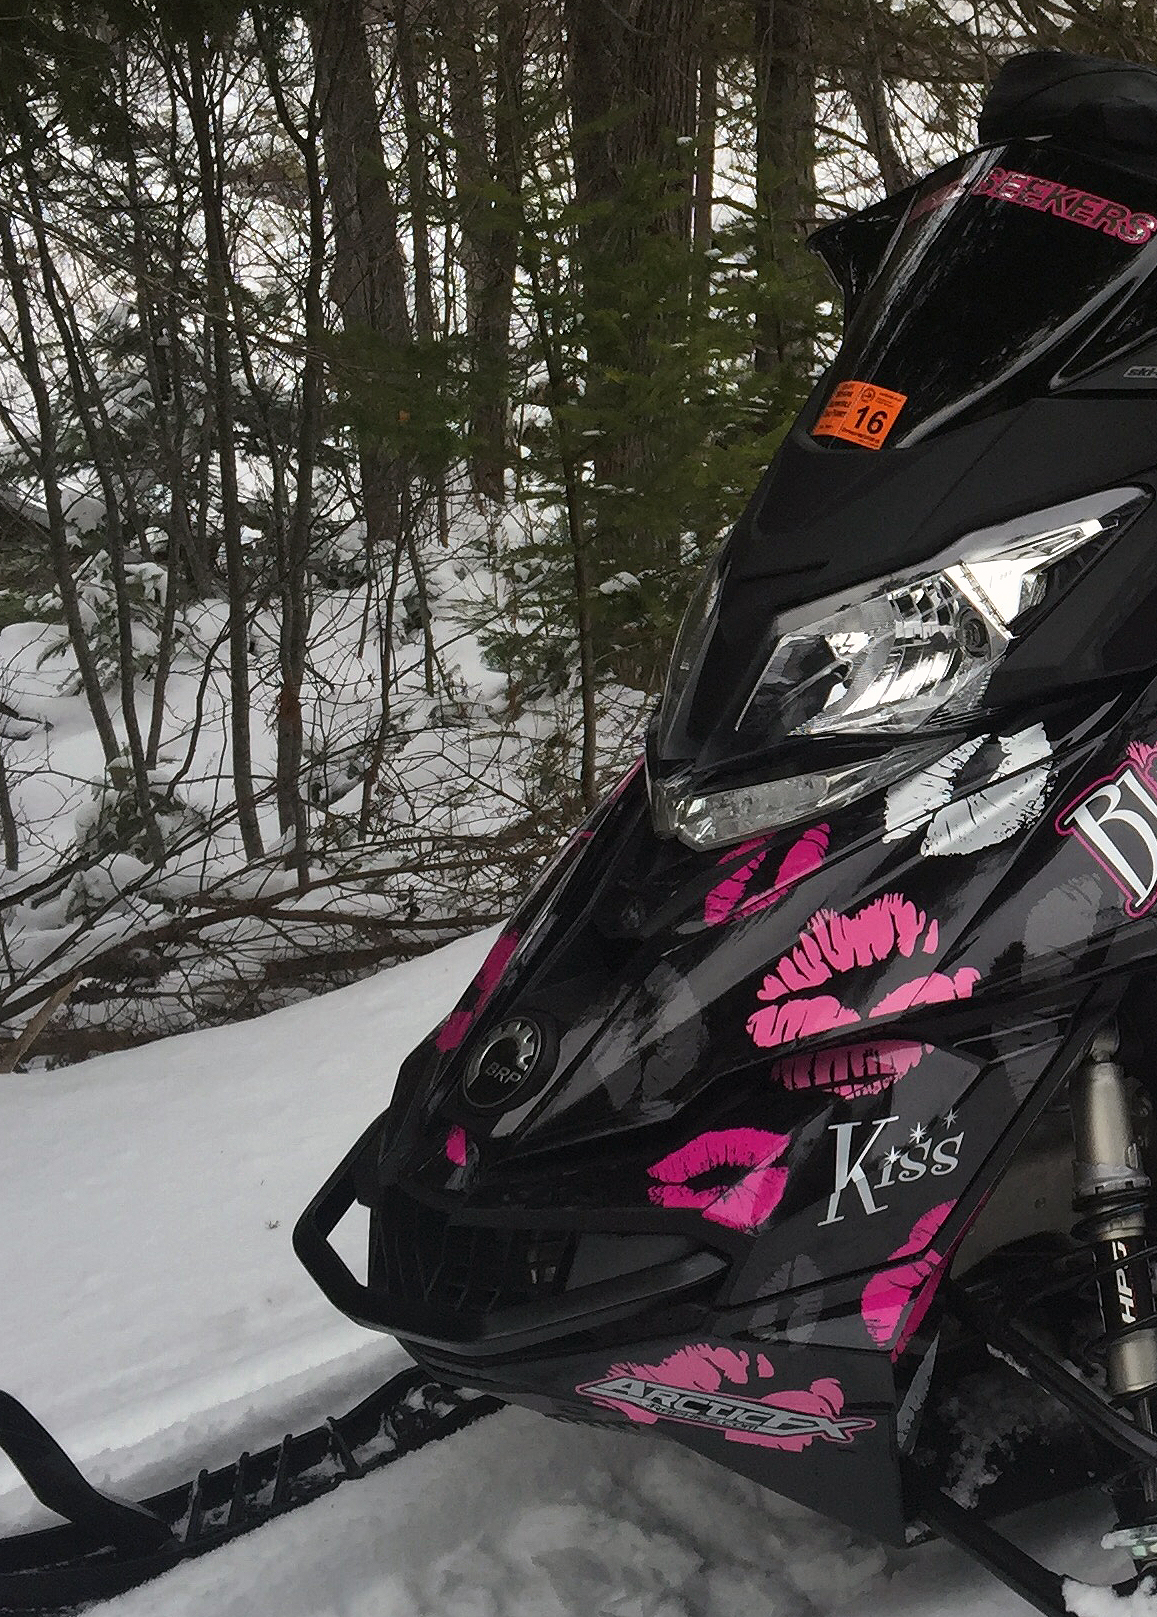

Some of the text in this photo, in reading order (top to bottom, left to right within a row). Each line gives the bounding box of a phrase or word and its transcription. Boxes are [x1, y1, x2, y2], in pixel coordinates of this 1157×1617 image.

[854, 405, 889, 435] 16
[485, 1061, 522, 1084] BRP
[817, 1114, 965, 1227] Kiss
